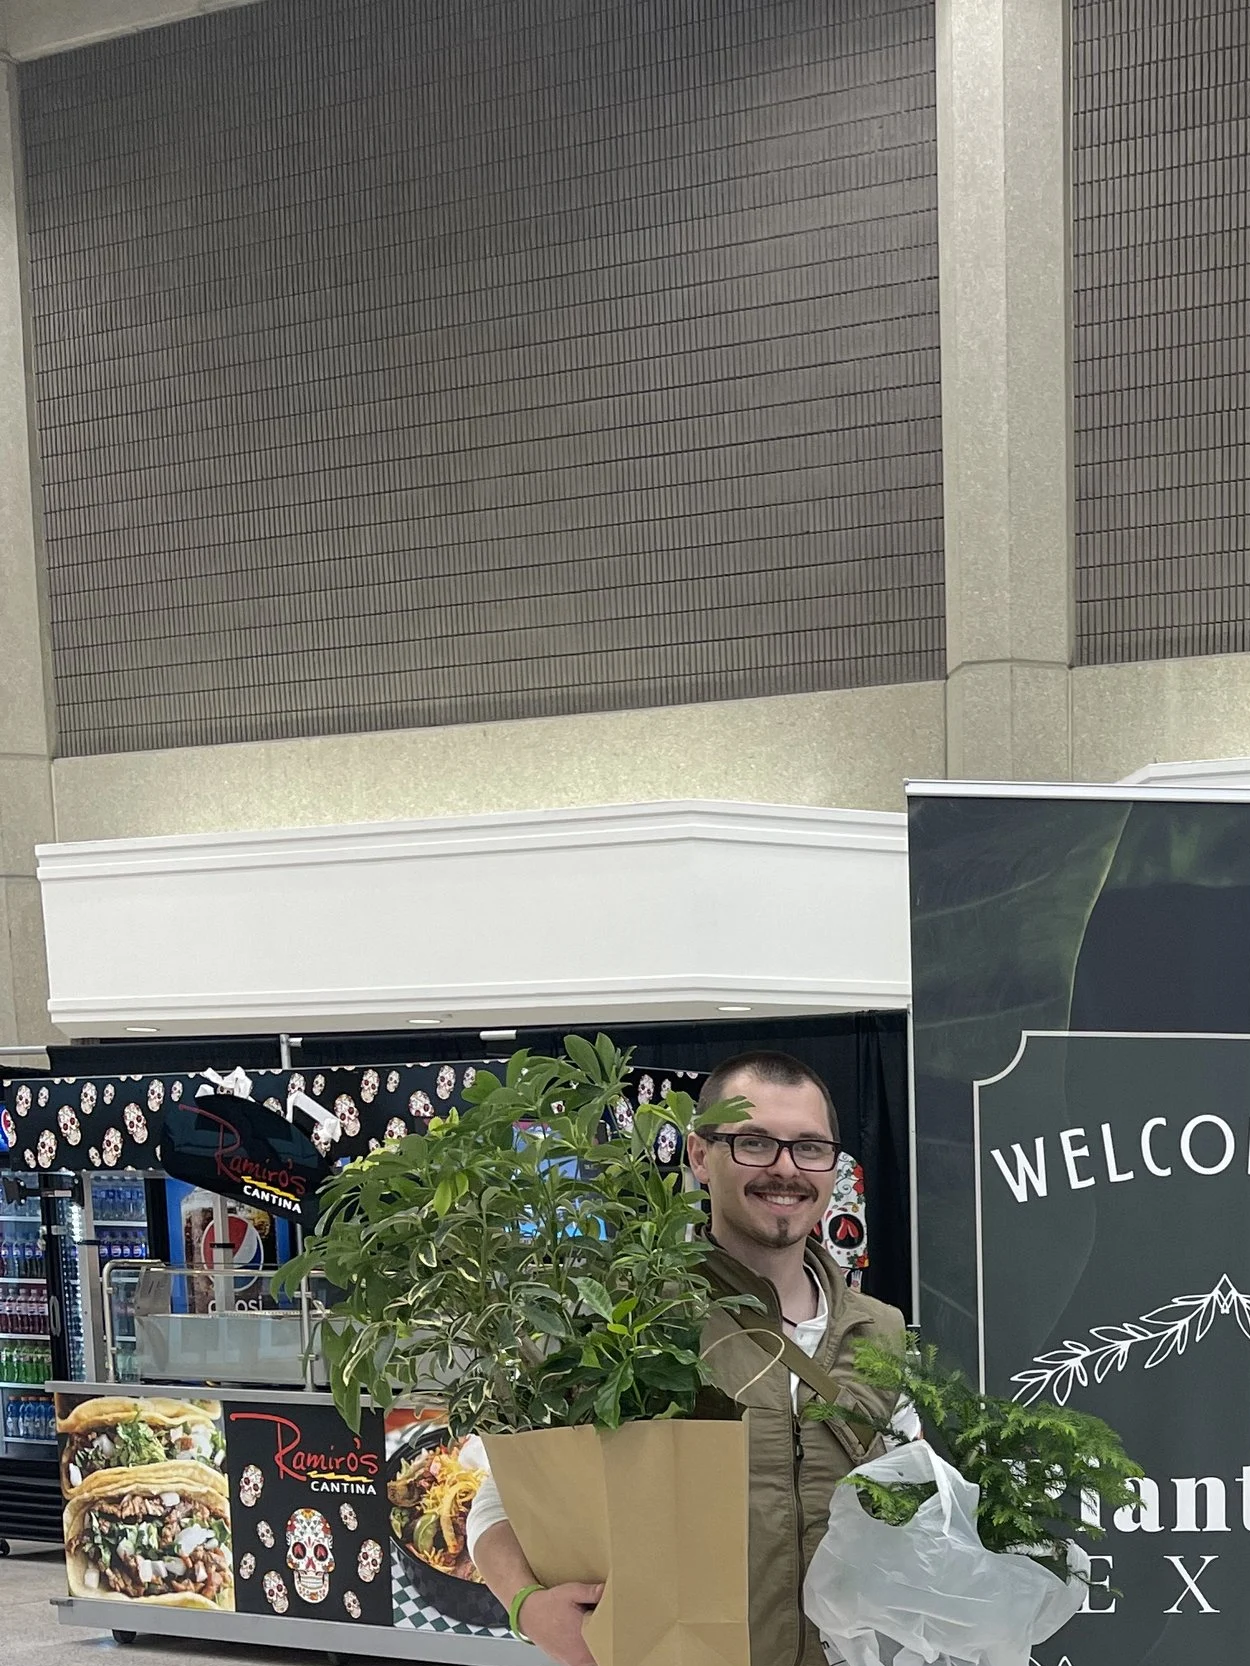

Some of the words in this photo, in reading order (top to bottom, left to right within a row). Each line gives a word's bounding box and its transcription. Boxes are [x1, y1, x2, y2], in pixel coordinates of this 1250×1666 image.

[178, 1103, 307, 1196] Ramiro's
[242, 1184, 302, 1214] CANTINA
[229, 1412, 379, 1482] Ramiro's
[310, 1480, 377, 1496] CANTINA
